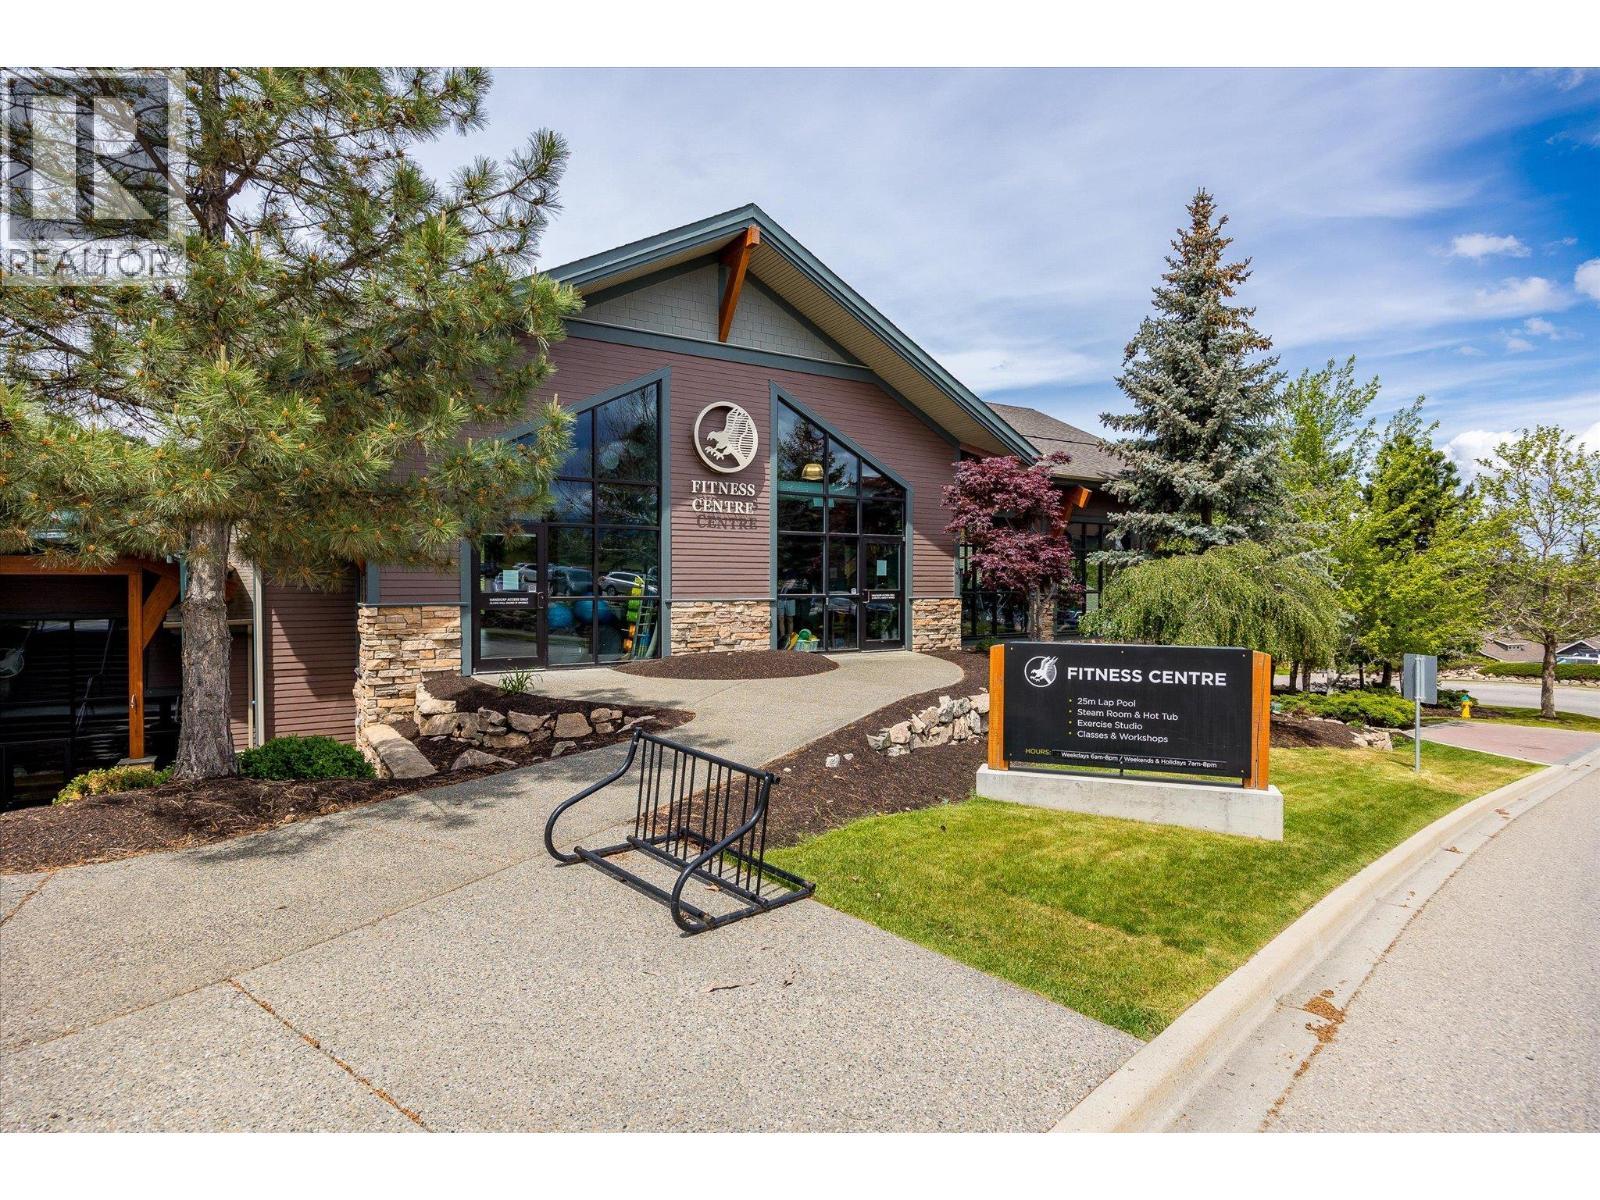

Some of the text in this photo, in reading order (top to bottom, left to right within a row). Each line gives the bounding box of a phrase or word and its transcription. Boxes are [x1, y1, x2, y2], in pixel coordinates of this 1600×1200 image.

[691, 480, 756, 496] FITNESS
[691, 498, 754, 514] CENTRE
[1067, 667, 1227, 686] FITNESS CENTRE
[1077, 697, 1136, 708] 25m Lap Pool
[1077, 708, 1179, 721] Steam Room & Hot Tub
[1077, 719, 1143, 730] Exercise Studio
[1077, 730, 1169, 744] Classes & Workshops
[1124, 756, 1154, 764] Weekends
[1161, 759, 1187, 767] Holidays
